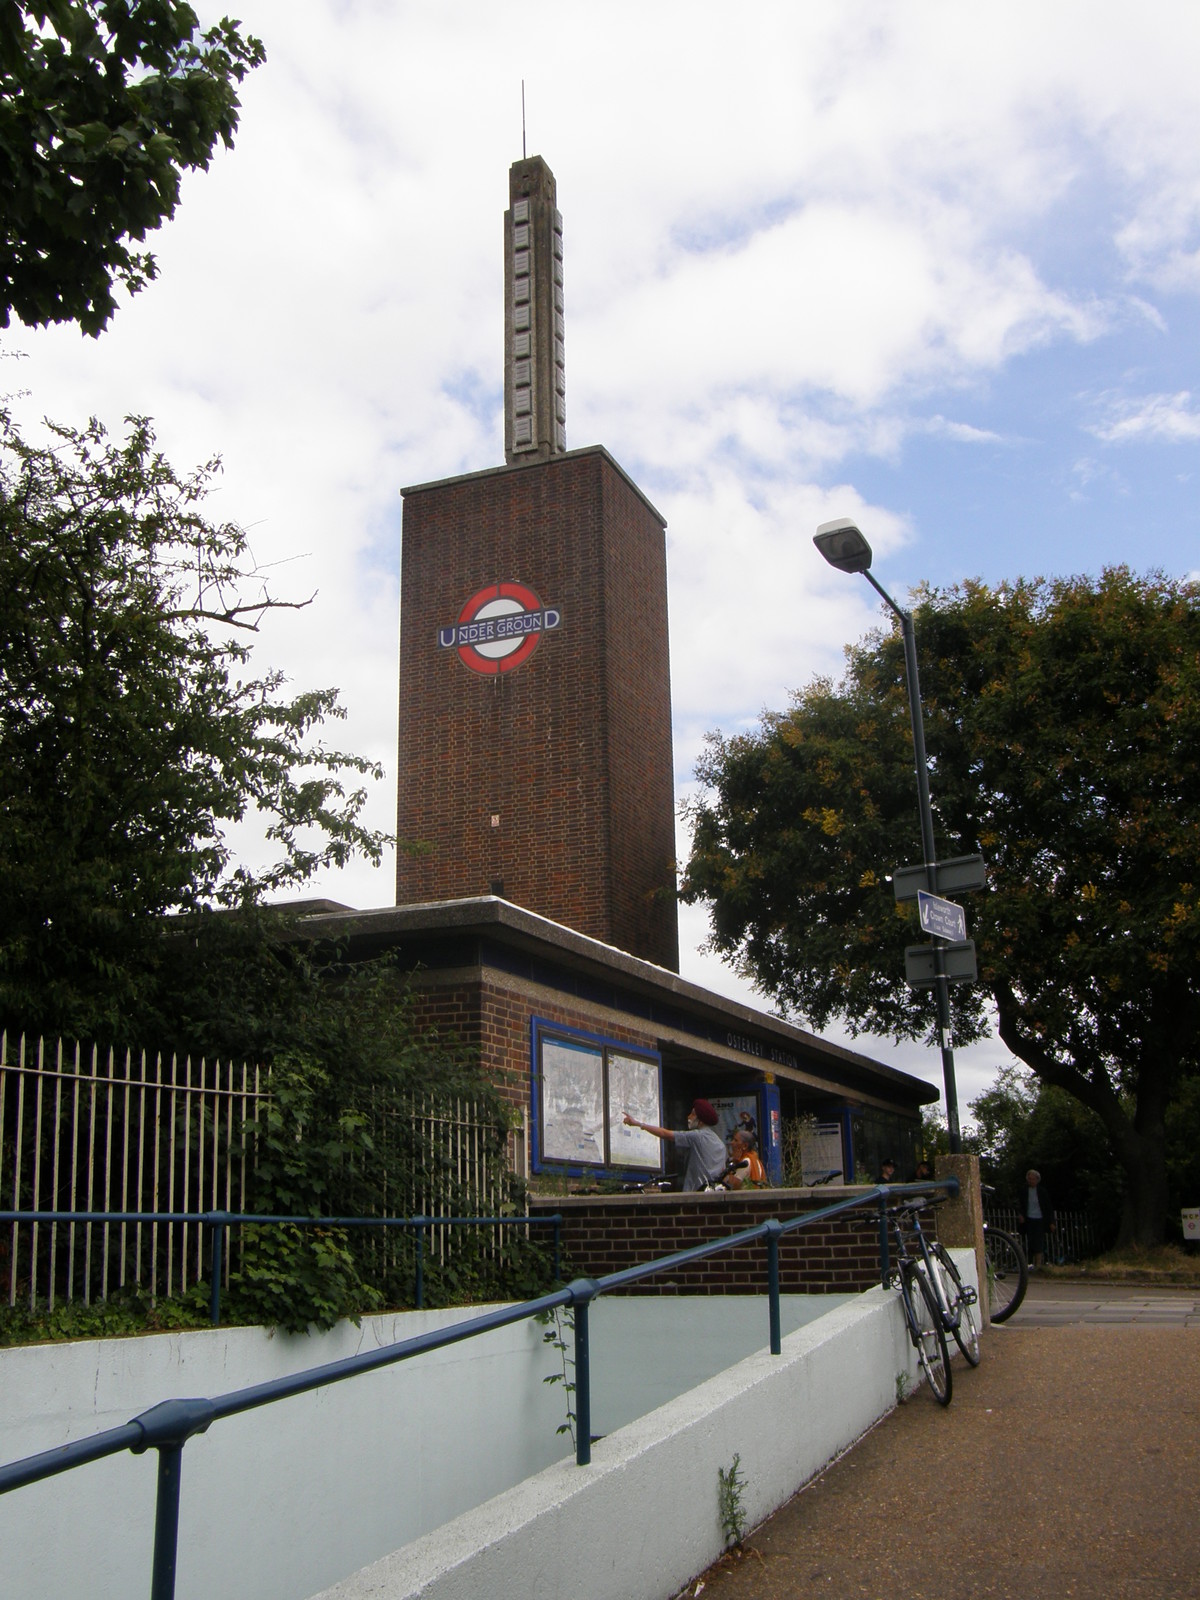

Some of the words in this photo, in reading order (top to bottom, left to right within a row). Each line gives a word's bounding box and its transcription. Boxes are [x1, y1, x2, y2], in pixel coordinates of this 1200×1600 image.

[440, 610, 560, 647] UNDERGROUND
[727, 1032, 764, 1056] OSTERLEY
[770, 1047, 798, 1069] STATION
